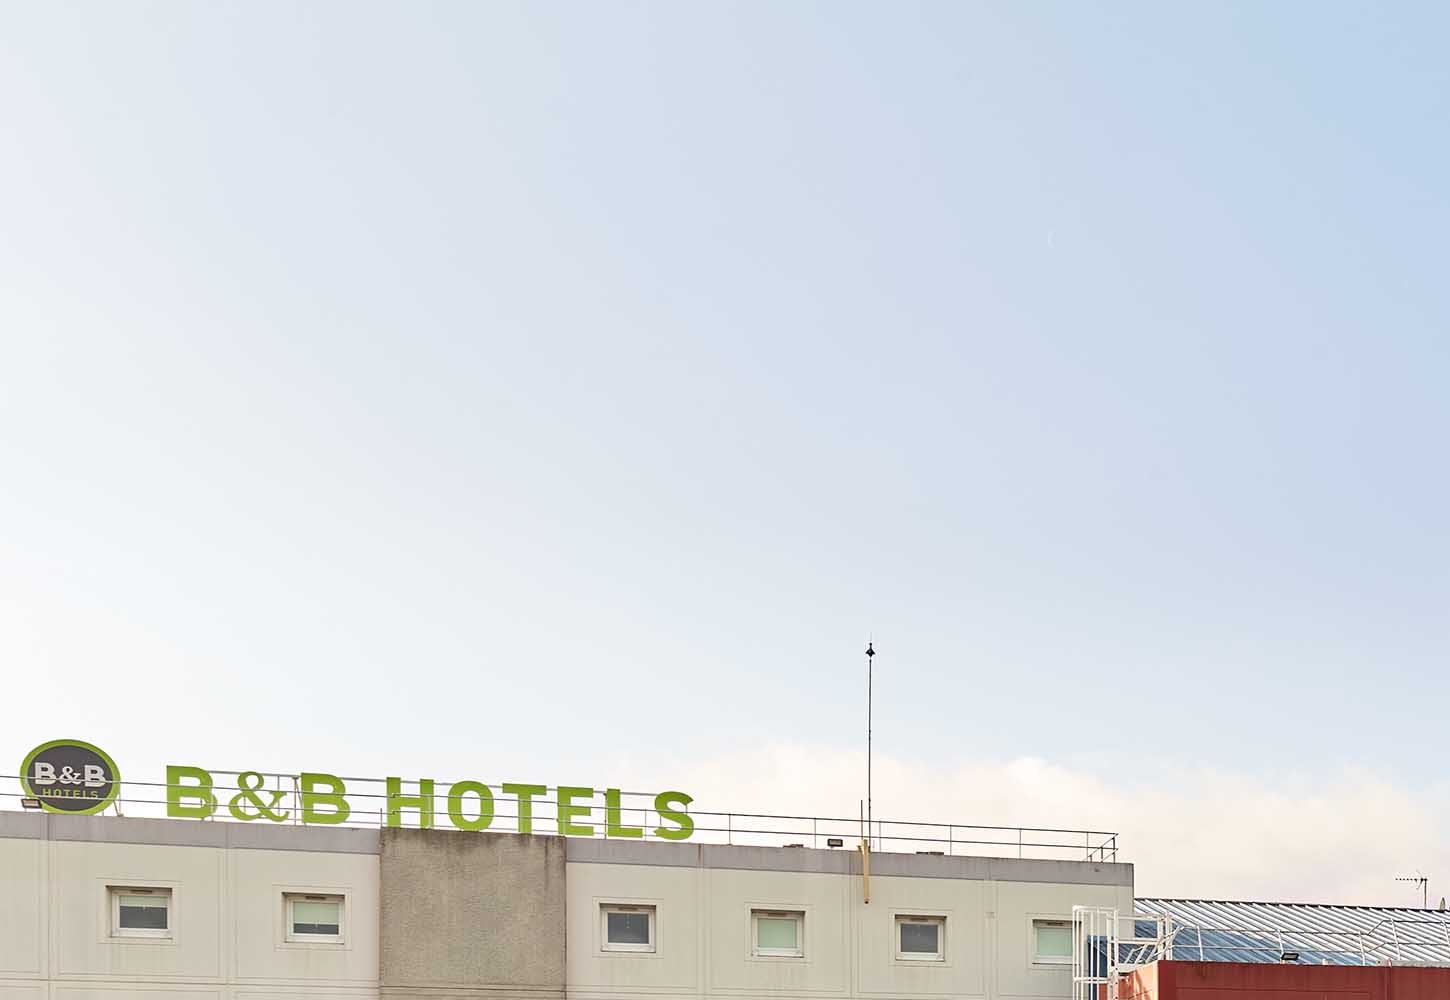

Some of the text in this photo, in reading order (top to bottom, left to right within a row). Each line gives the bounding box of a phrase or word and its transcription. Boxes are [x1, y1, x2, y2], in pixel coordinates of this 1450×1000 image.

[35, 762, 106, 788] B&B
[43, 788, 98, 799] HOTELS
[166, 765, 695, 841] B&B HOTELS
